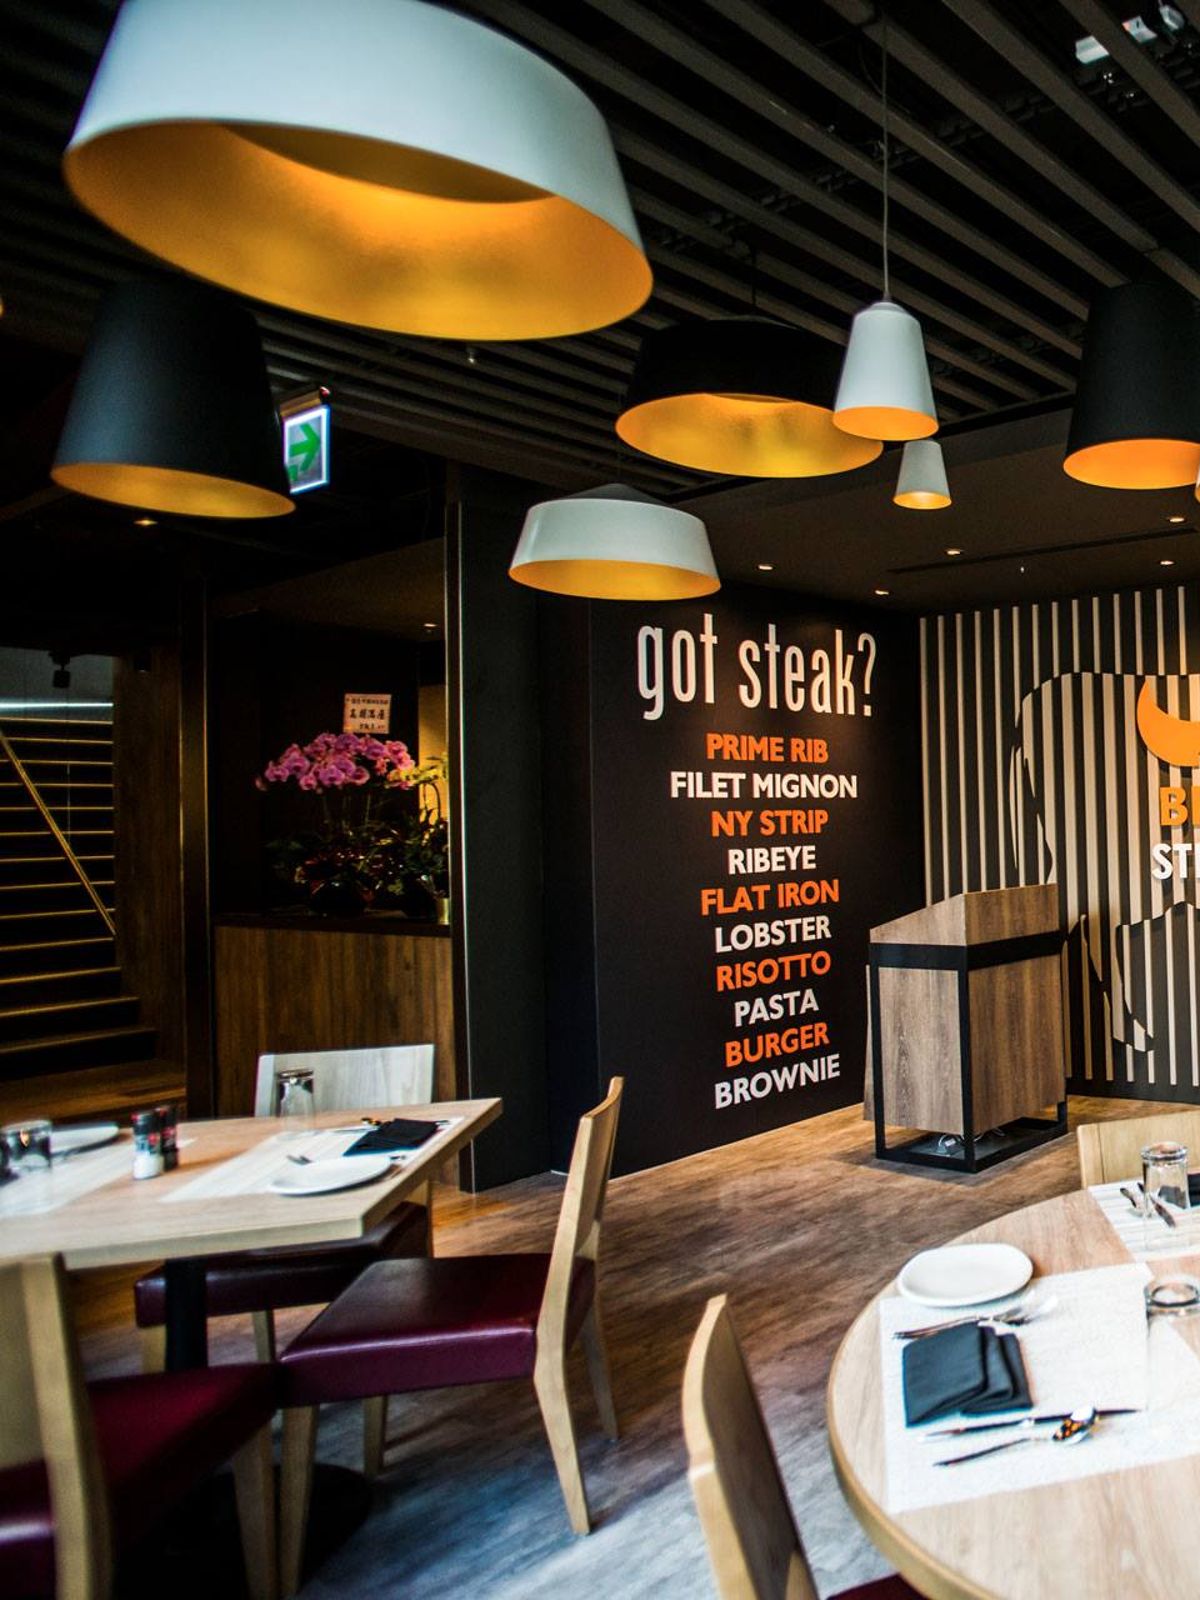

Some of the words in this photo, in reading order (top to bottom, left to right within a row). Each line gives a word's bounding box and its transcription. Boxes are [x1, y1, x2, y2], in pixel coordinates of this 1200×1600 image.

[637, 613, 718, 720] got
[738, 623, 876, 717] steak?
[706, 732, 785, 762] PRIME
[790, 738, 829, 763] RIB
[670, 771, 746, 799] FILET
[752, 773, 858, 799] MIGNON
[710, 811, 753, 837] NY
[759, 809, 829, 837] STRIP
[727, 844, 817, 875] RIBEYE
[700, 885, 771, 917] FLAT
[777, 879, 840, 908] IRON
[714, 915, 832, 953] LOBSTER
[716, 951, 831, 992] RISOTTO
[734, 988, 820, 1027] PASTA
[724, 1022, 830, 1068] BURGER
[714, 1053, 841, 1110] BROWNIE
